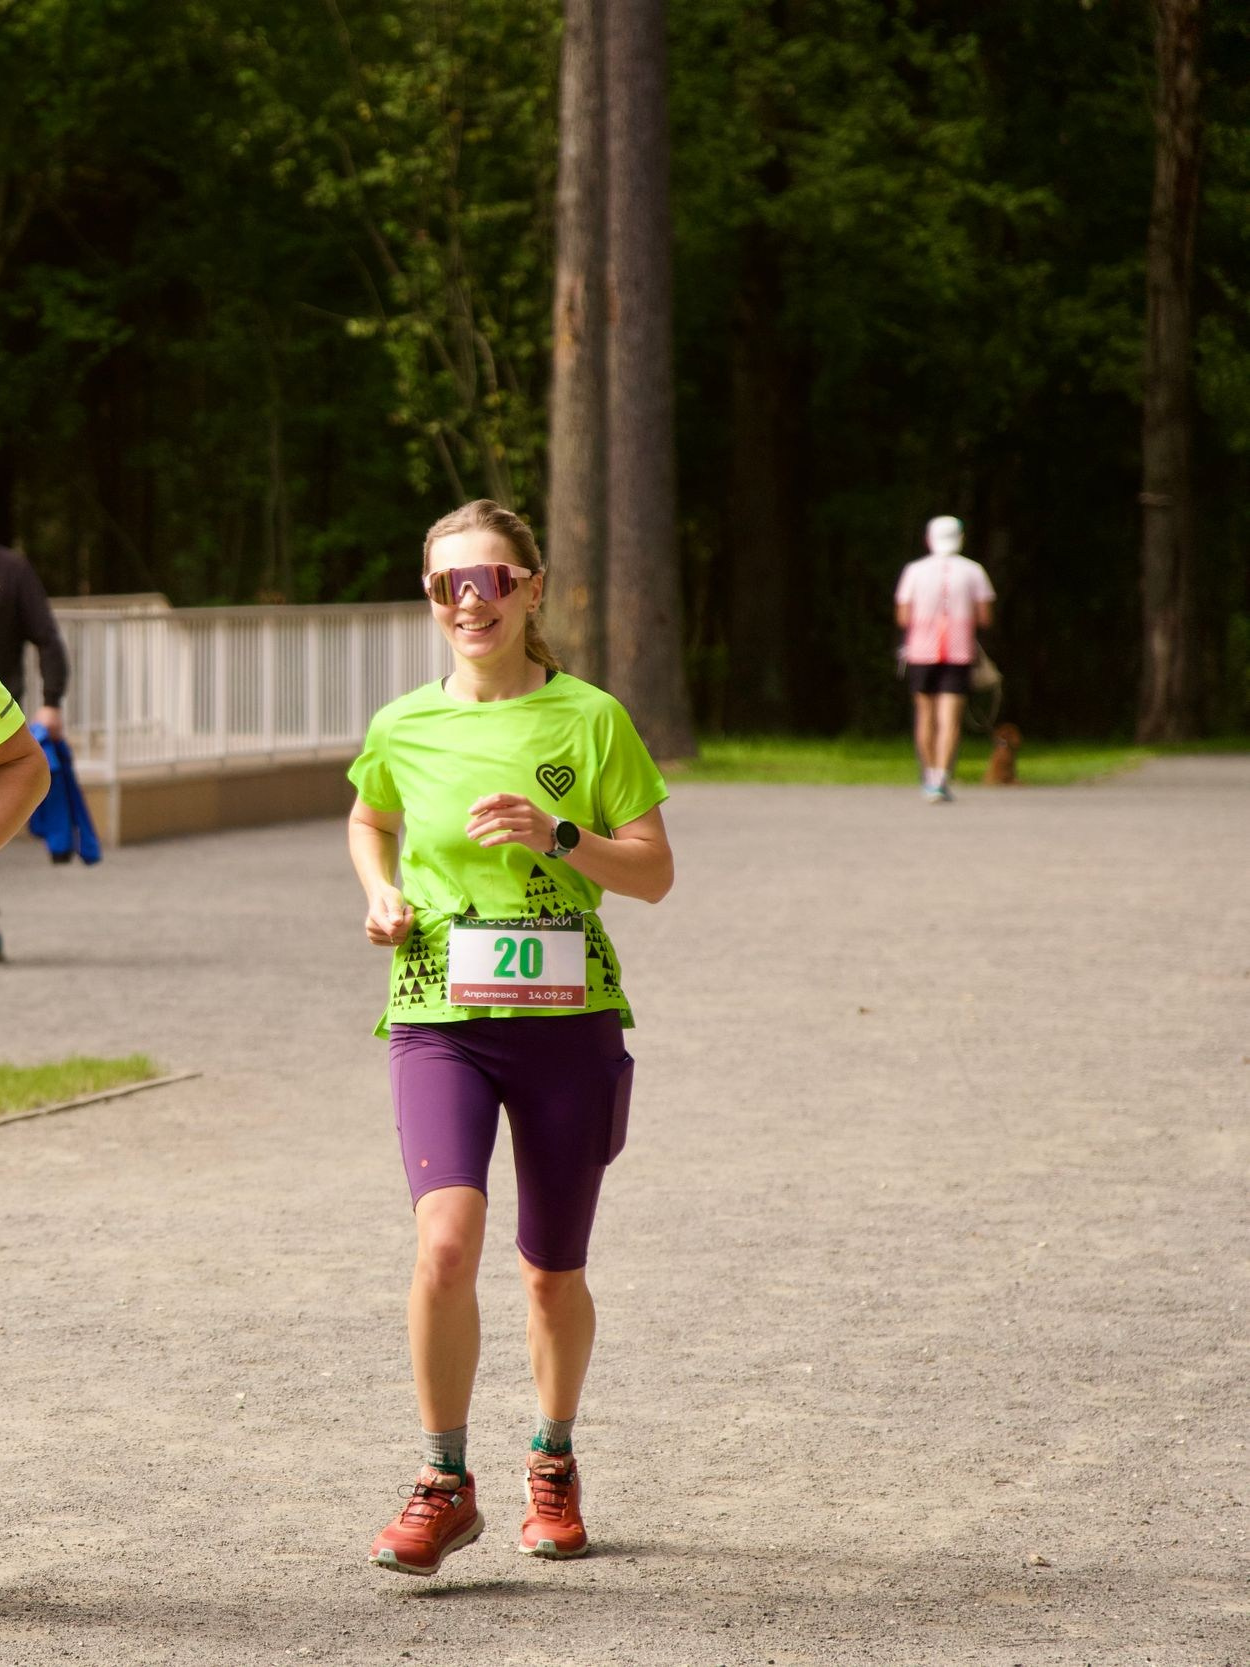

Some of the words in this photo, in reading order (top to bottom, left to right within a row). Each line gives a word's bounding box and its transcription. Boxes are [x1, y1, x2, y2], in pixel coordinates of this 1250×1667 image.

[493, 937, 544, 979] 20
[463, 989, 519, 1000] Апрелевка
[528, 991, 574, 1000] 14.09.25
